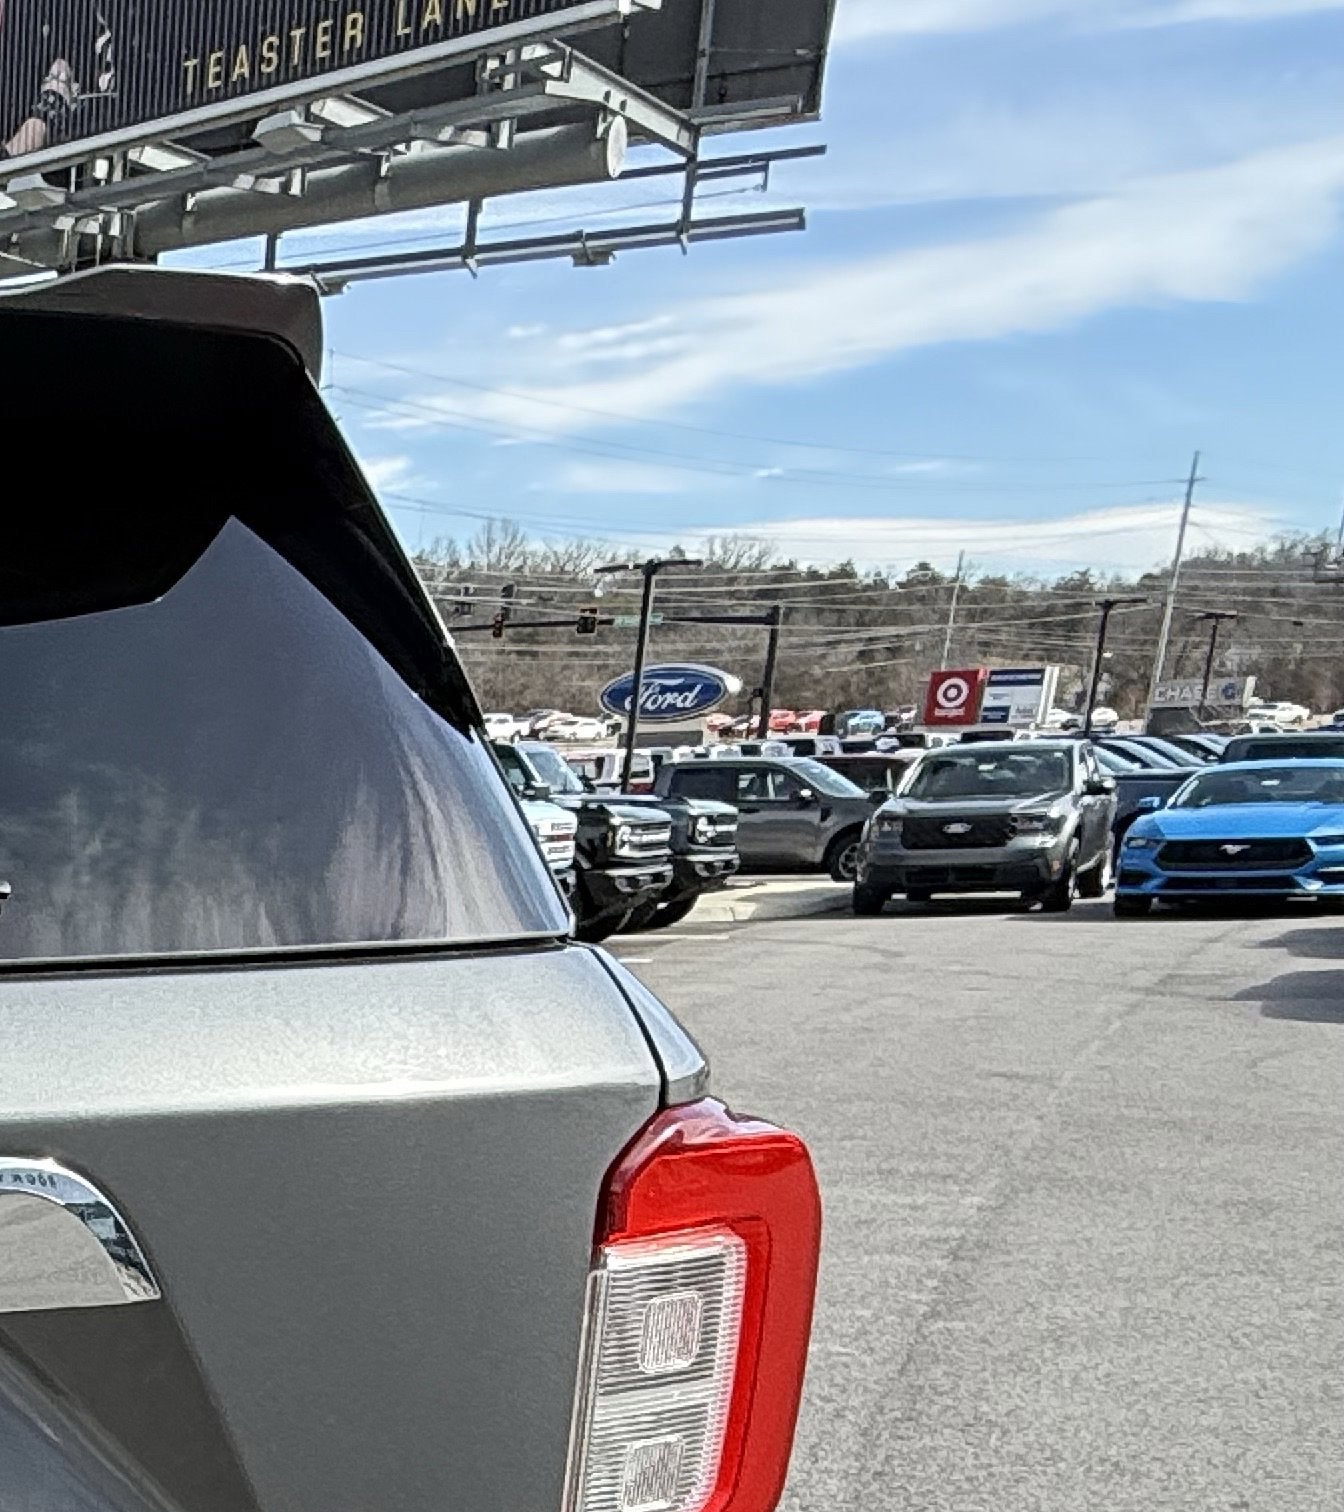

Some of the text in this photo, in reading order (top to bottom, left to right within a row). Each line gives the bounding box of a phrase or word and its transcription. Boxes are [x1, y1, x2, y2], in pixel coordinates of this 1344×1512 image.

[184, 0, 508, 96] TEASTER LAN
[624, 677, 703, 711] Ford
